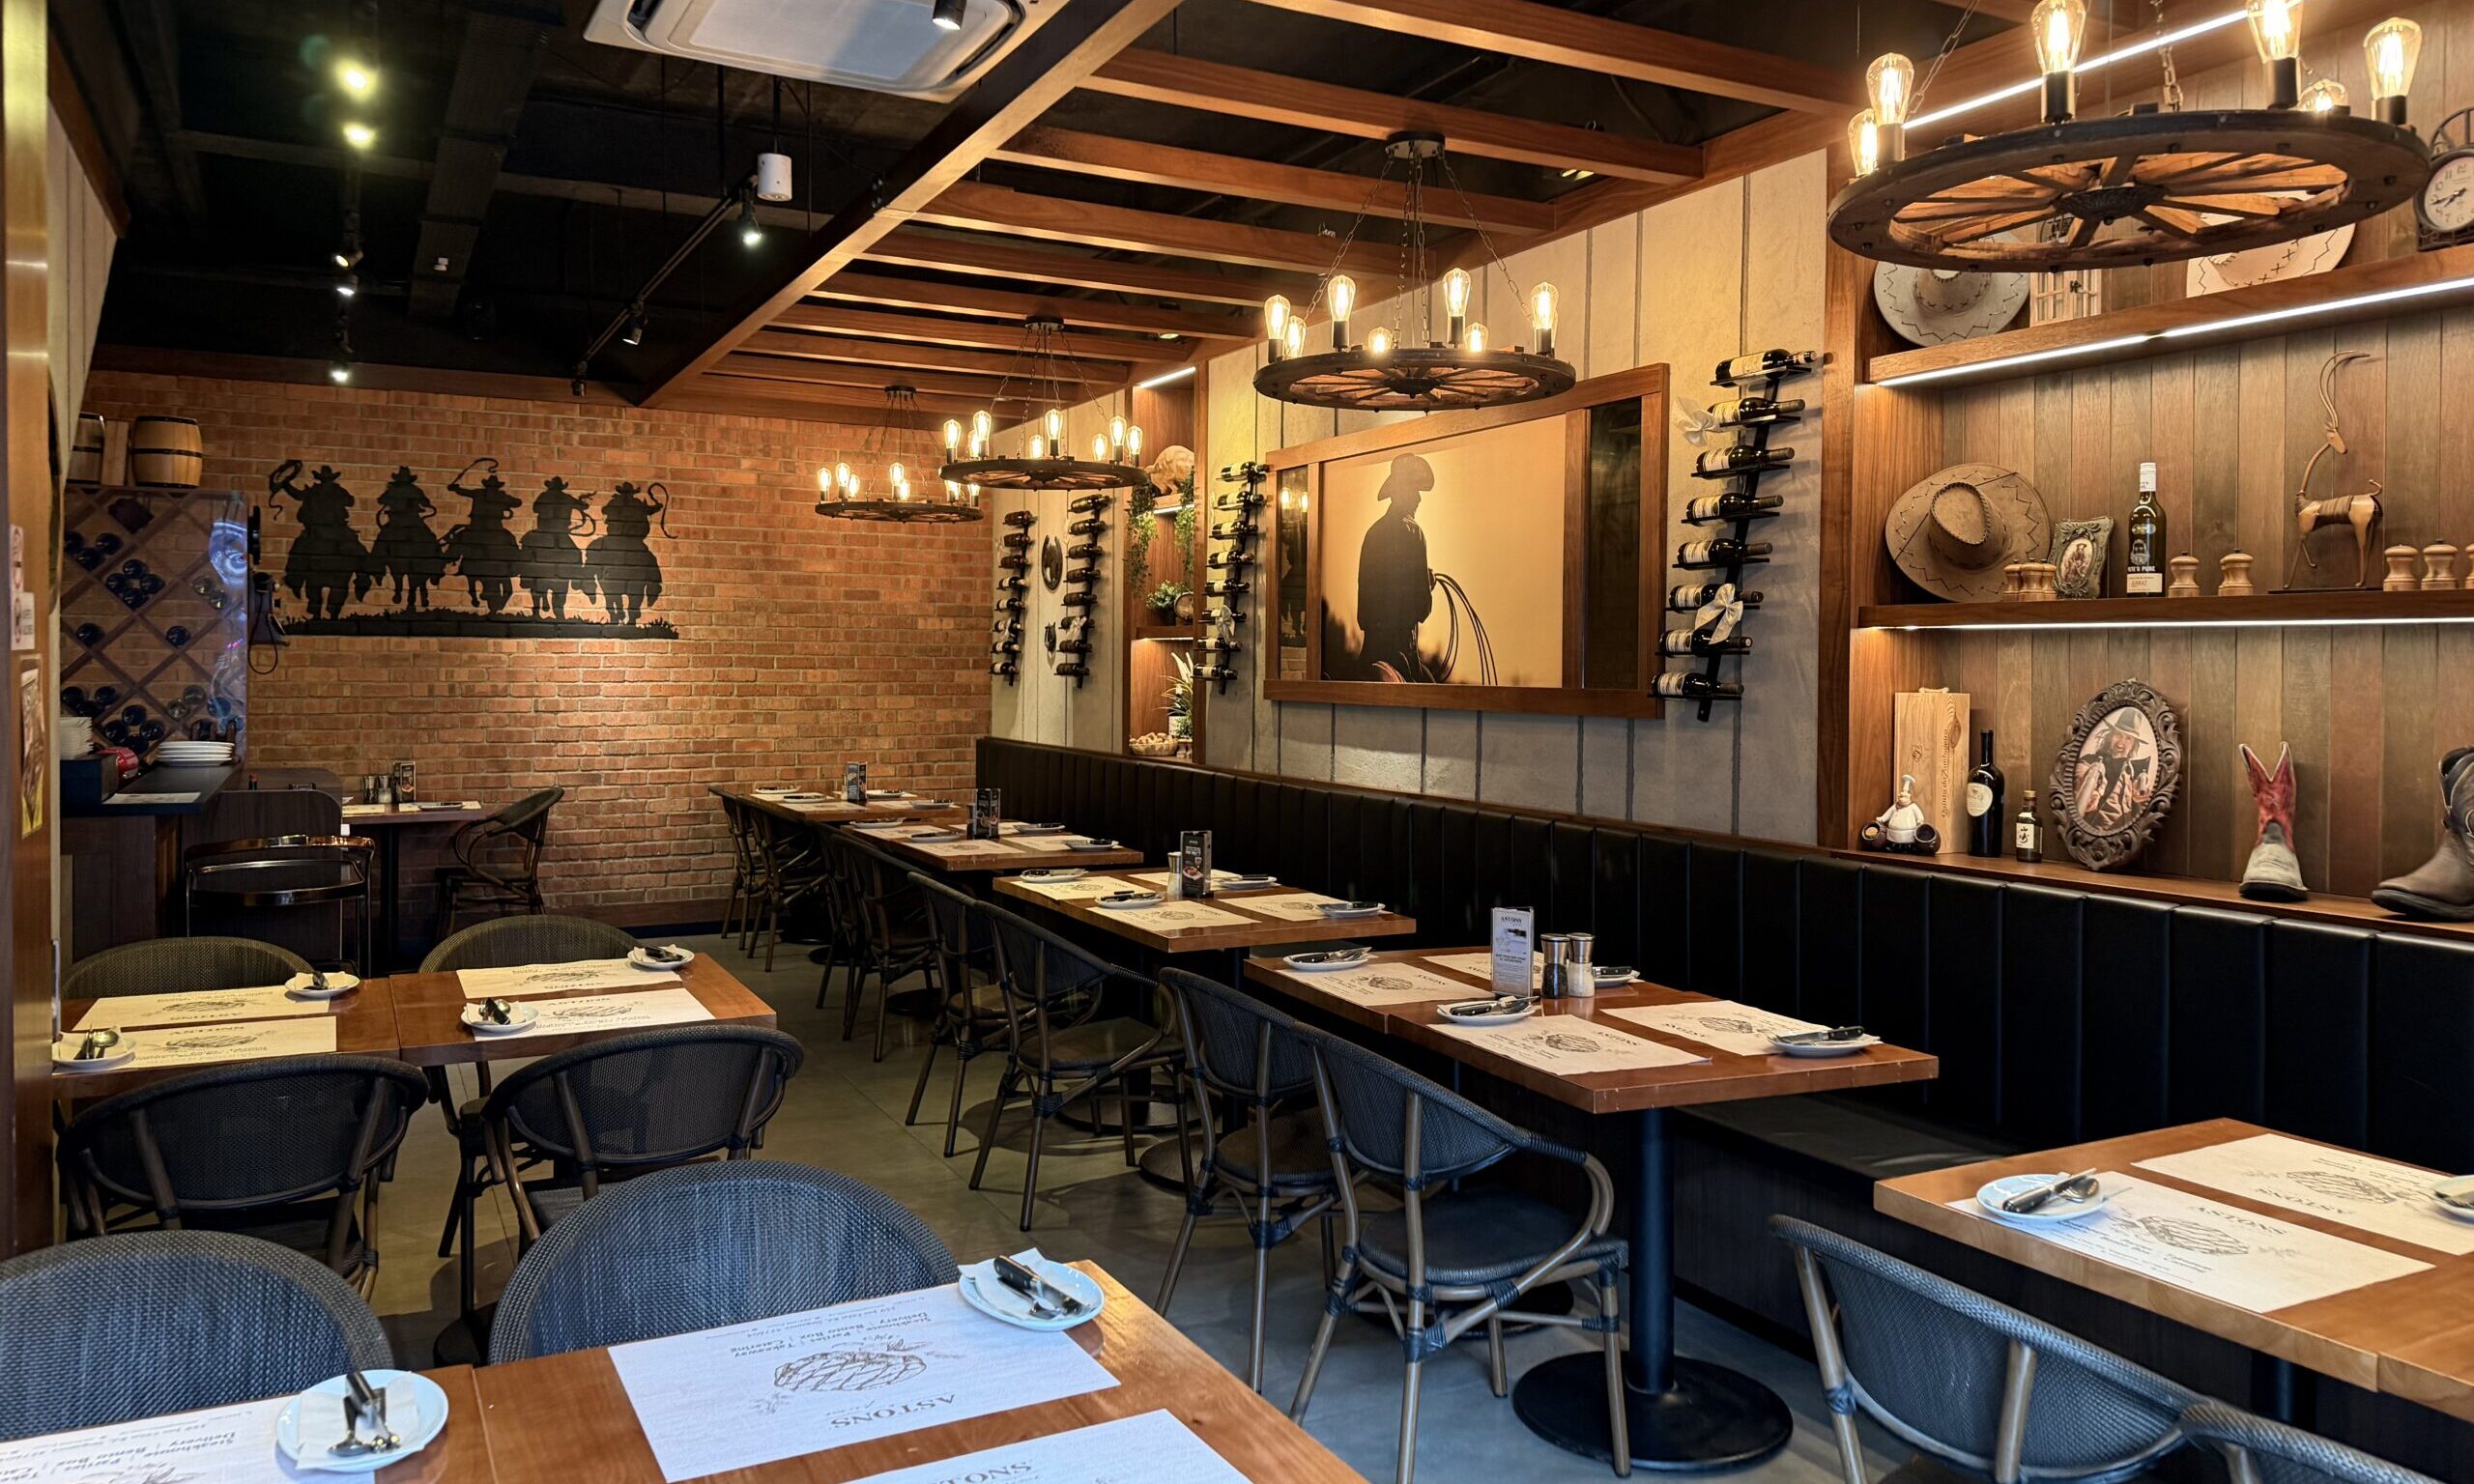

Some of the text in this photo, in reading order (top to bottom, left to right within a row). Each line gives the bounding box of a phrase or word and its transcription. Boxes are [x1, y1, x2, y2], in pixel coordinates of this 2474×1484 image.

[829, 1393, 956, 1429] ASTONS
[143, 1438, 234, 1459] Steakhouse
[170, 1432, 236, 1447] Delivery
[64, 1457, 121, 1473] Parties
